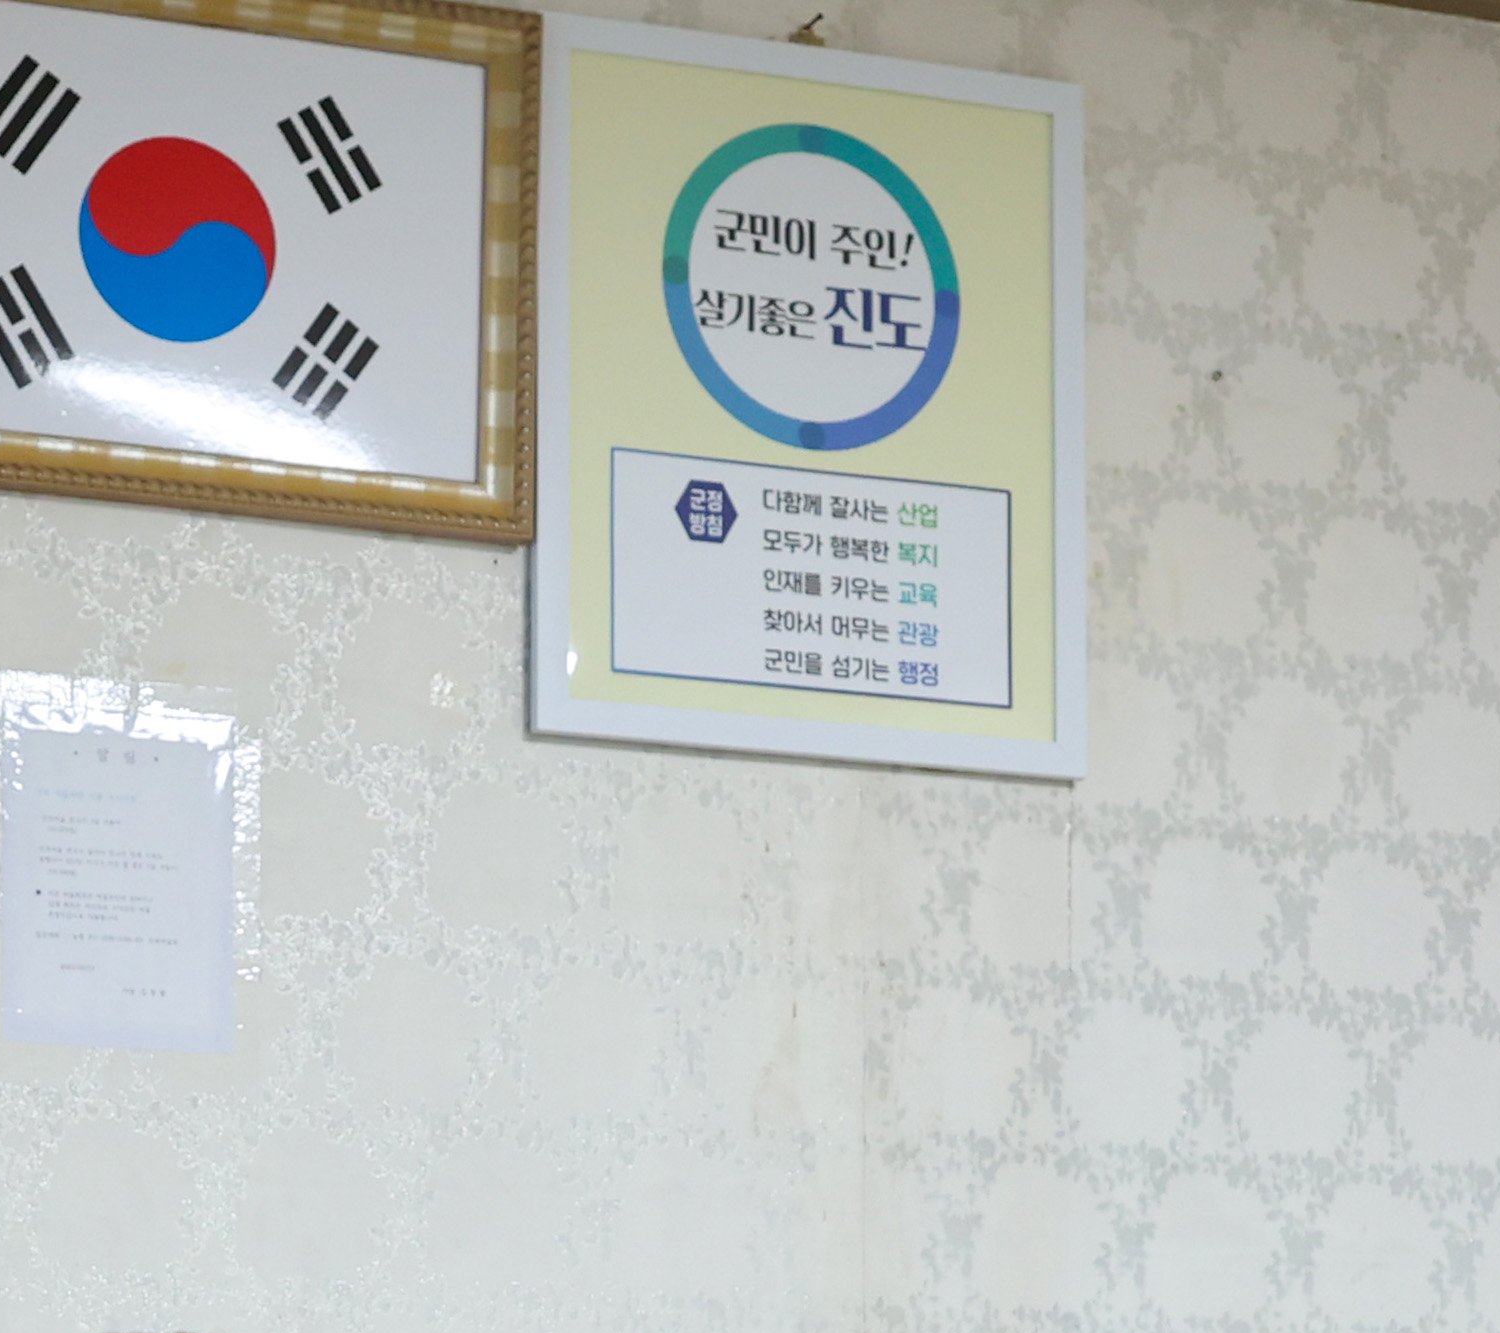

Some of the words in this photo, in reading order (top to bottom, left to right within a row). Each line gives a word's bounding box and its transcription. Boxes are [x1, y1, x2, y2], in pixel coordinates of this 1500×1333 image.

[713, 209, 817, 261] 군민이
[830, 224, 914, 271] 주인!
[695, 289, 817, 339] 살기좋은
[823, 286, 927, 351] 진도
[690, 488, 723, 513] 군정
[762, 488, 822, 517] 다함께
[830, 495, 889, 524] 잘사는
[897, 502, 938, 529] 산업
[689, 513, 723, 537] 방침
[763, 528, 822, 556] 모두가
[830, 535, 889, 564] 행복한
[898, 542, 938, 568] 복지
[763, 568, 822, 597] 인재를
[831, 575, 889, 603] 키우는
[898, 581, 938, 608] 교육
[763, 608, 822, 635] 찾아서
[831, 615, 889, 643] 머무는
[898, 621, 938, 647] 관광
[764, 648, 823, 676] 군민을
[831, 655, 890, 683] 섬기는
[898, 661, 938, 687] 행정
